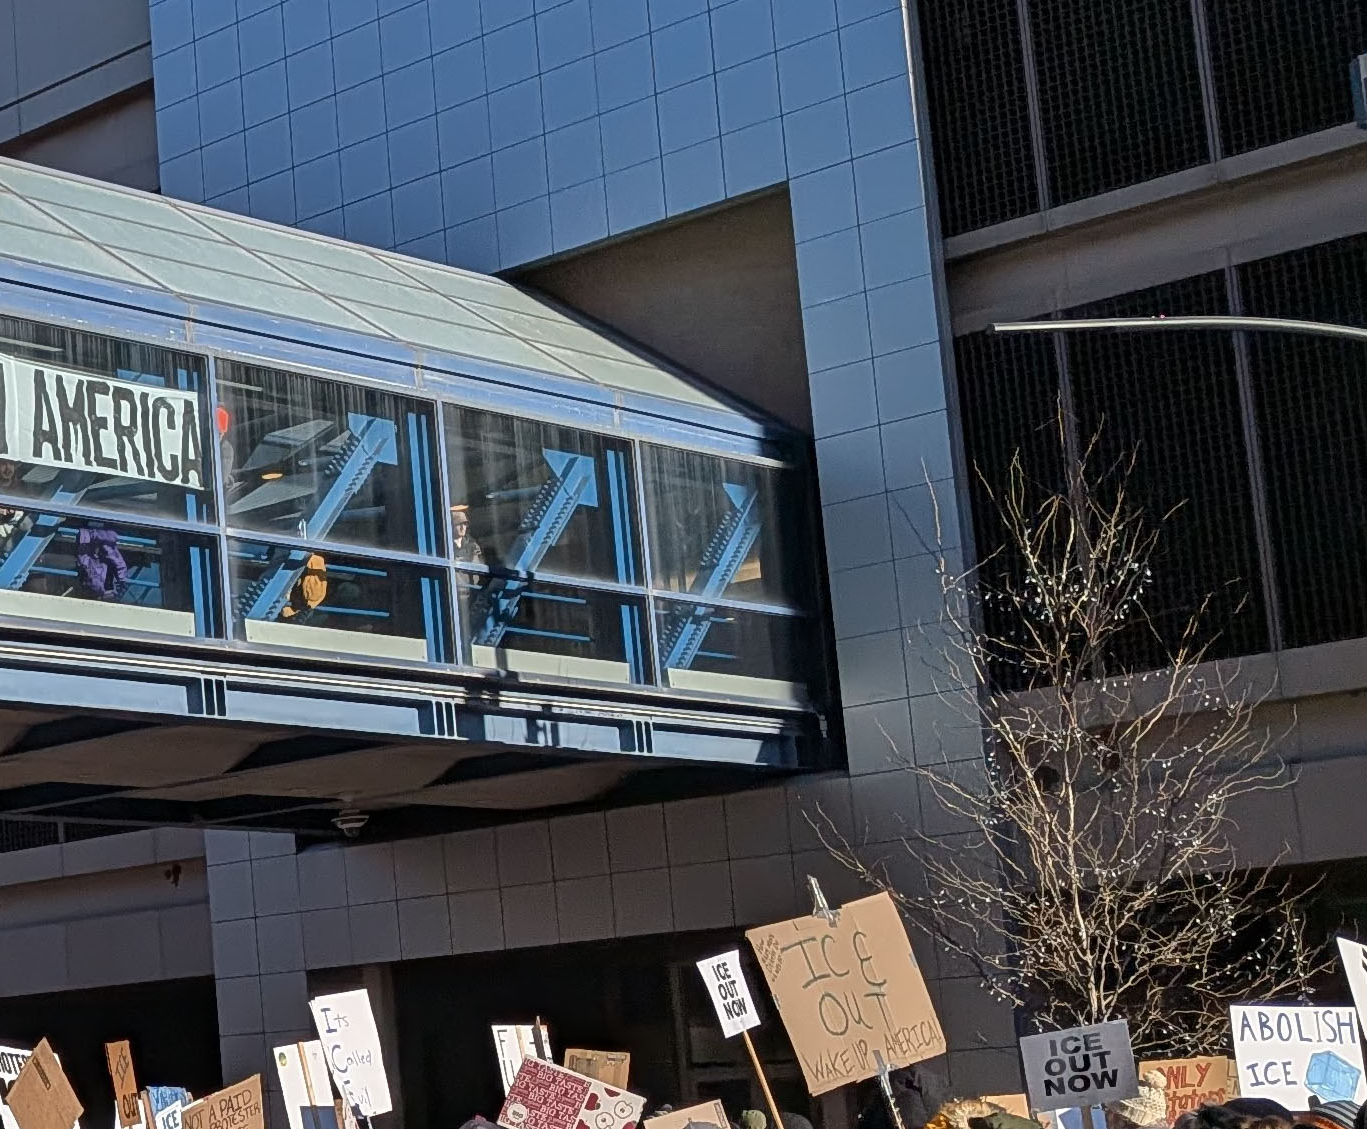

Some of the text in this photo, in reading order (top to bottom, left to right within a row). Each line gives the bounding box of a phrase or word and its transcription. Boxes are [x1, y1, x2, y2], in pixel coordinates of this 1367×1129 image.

[33, 369, 204, 488] AMERICA
[712, 961, 732, 981] ICE
[781, 931, 887, 989] ICE
[718, 980, 738, 1000] OUT
[321, 1008, 350, 1033] Its
[723, 997, 747, 1020] NOW
[819, 992, 892, 1036] OUT
[1240, 1010, 1356, 1044] ABOLISH
[1049, 1032, 1104, 1056] ICE
[331, 1045, 372, 1073] Called
[802, 1051, 853, 1082] WAKE
[852, 1039, 869, 1071] UP
[1045, 1051, 1112, 1076] OUT
[1044, 1069, 1118, 1097] NOW
[1246, 1061, 1297, 1087] ICE
[123, 1092, 138, 1119] OUT
[209, 1105, 217, 1122] A
[219, 1089, 253, 1116] PAID
